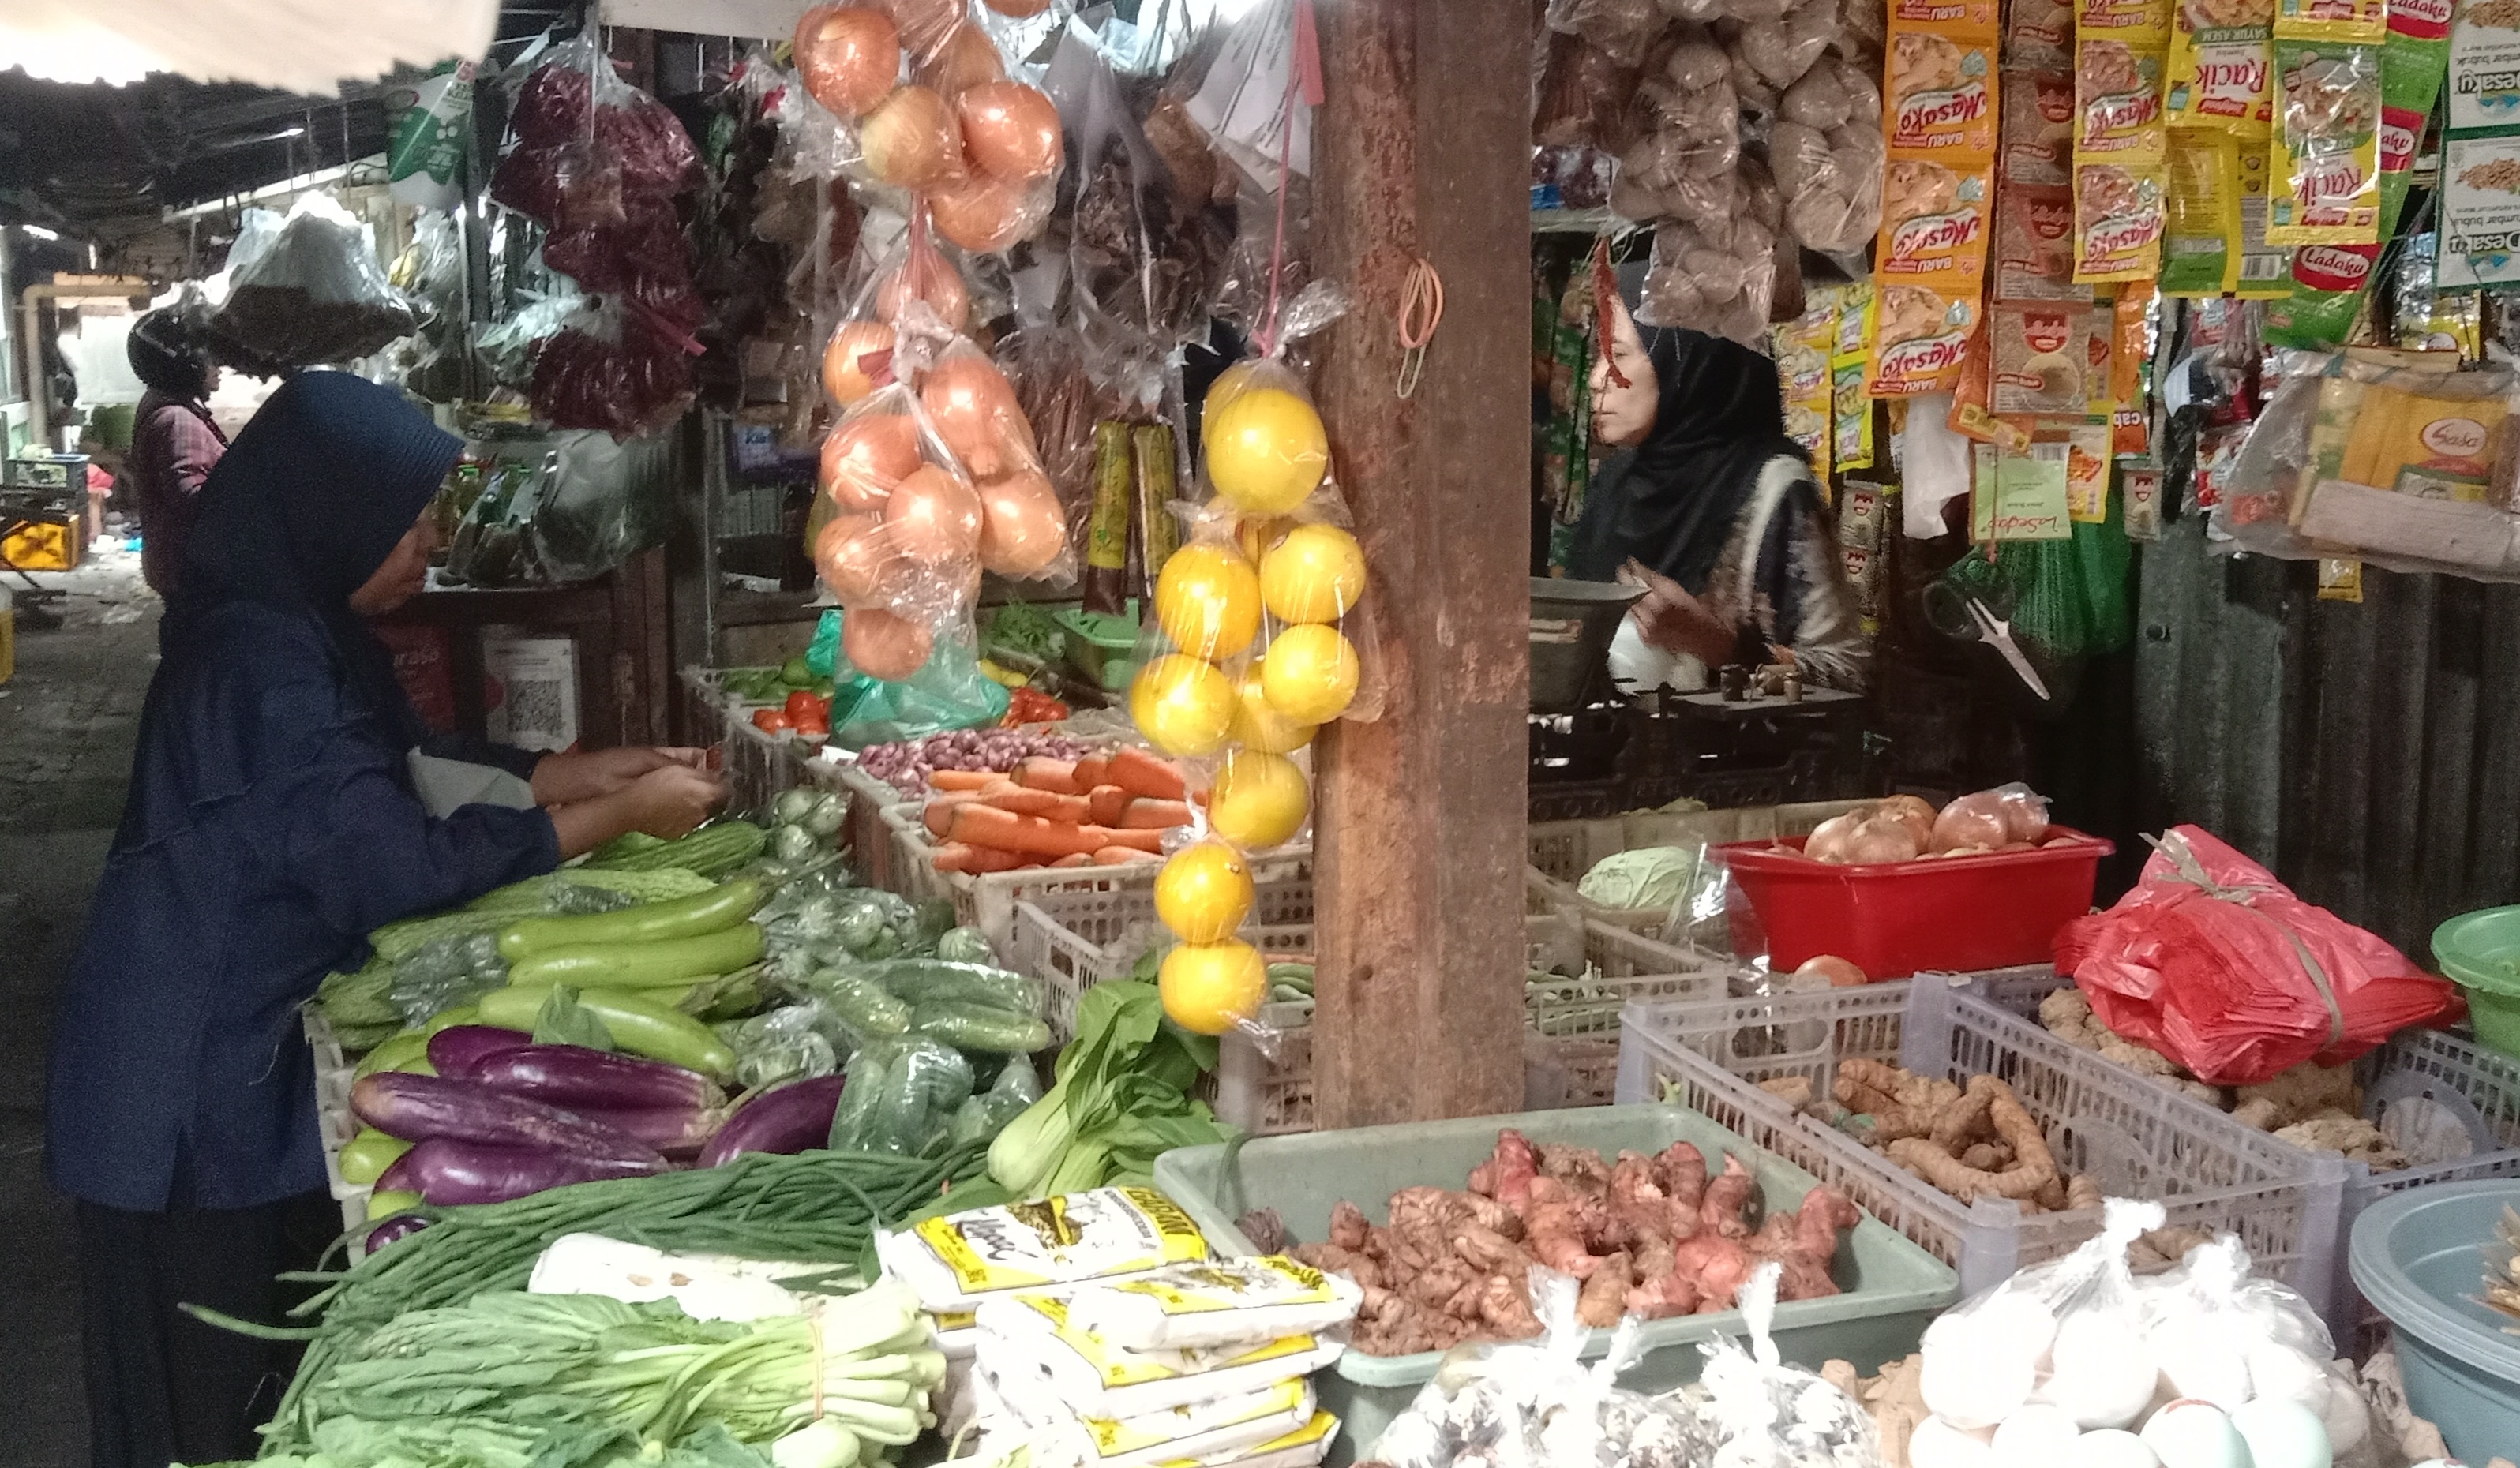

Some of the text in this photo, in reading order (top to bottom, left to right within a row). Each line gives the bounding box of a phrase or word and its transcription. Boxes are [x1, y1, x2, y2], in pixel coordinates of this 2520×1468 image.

[1930, 5, 1966, 21] BARU
[2112, 12, 2145, 27] BARU
[2202, 28, 2267, 42] SAYUR ASEM
[2195, 58, 2268, 95] Racik
[1900, 92, 1986, 133] Masako
[2086, 94, 2162, 133] Masak
[1927, 131, 1964, 148] BARU
[2108, 134, 2139, 152] BARU
[2297, 168, 2362, 206] Racik
[2487, 214, 2520, 227] umbar
[1896, 216, 1982, 259] Masako
[1916, 257, 1953, 273] BARU
[2304, 248, 2364, 275] Ladaku
[1883, 339, 1967, 380] Masako
[1902, 376, 1938, 393] BARU
[2113, 411, 2141, 430] cab
[1126, 1189, 1196, 1237] GARAM
